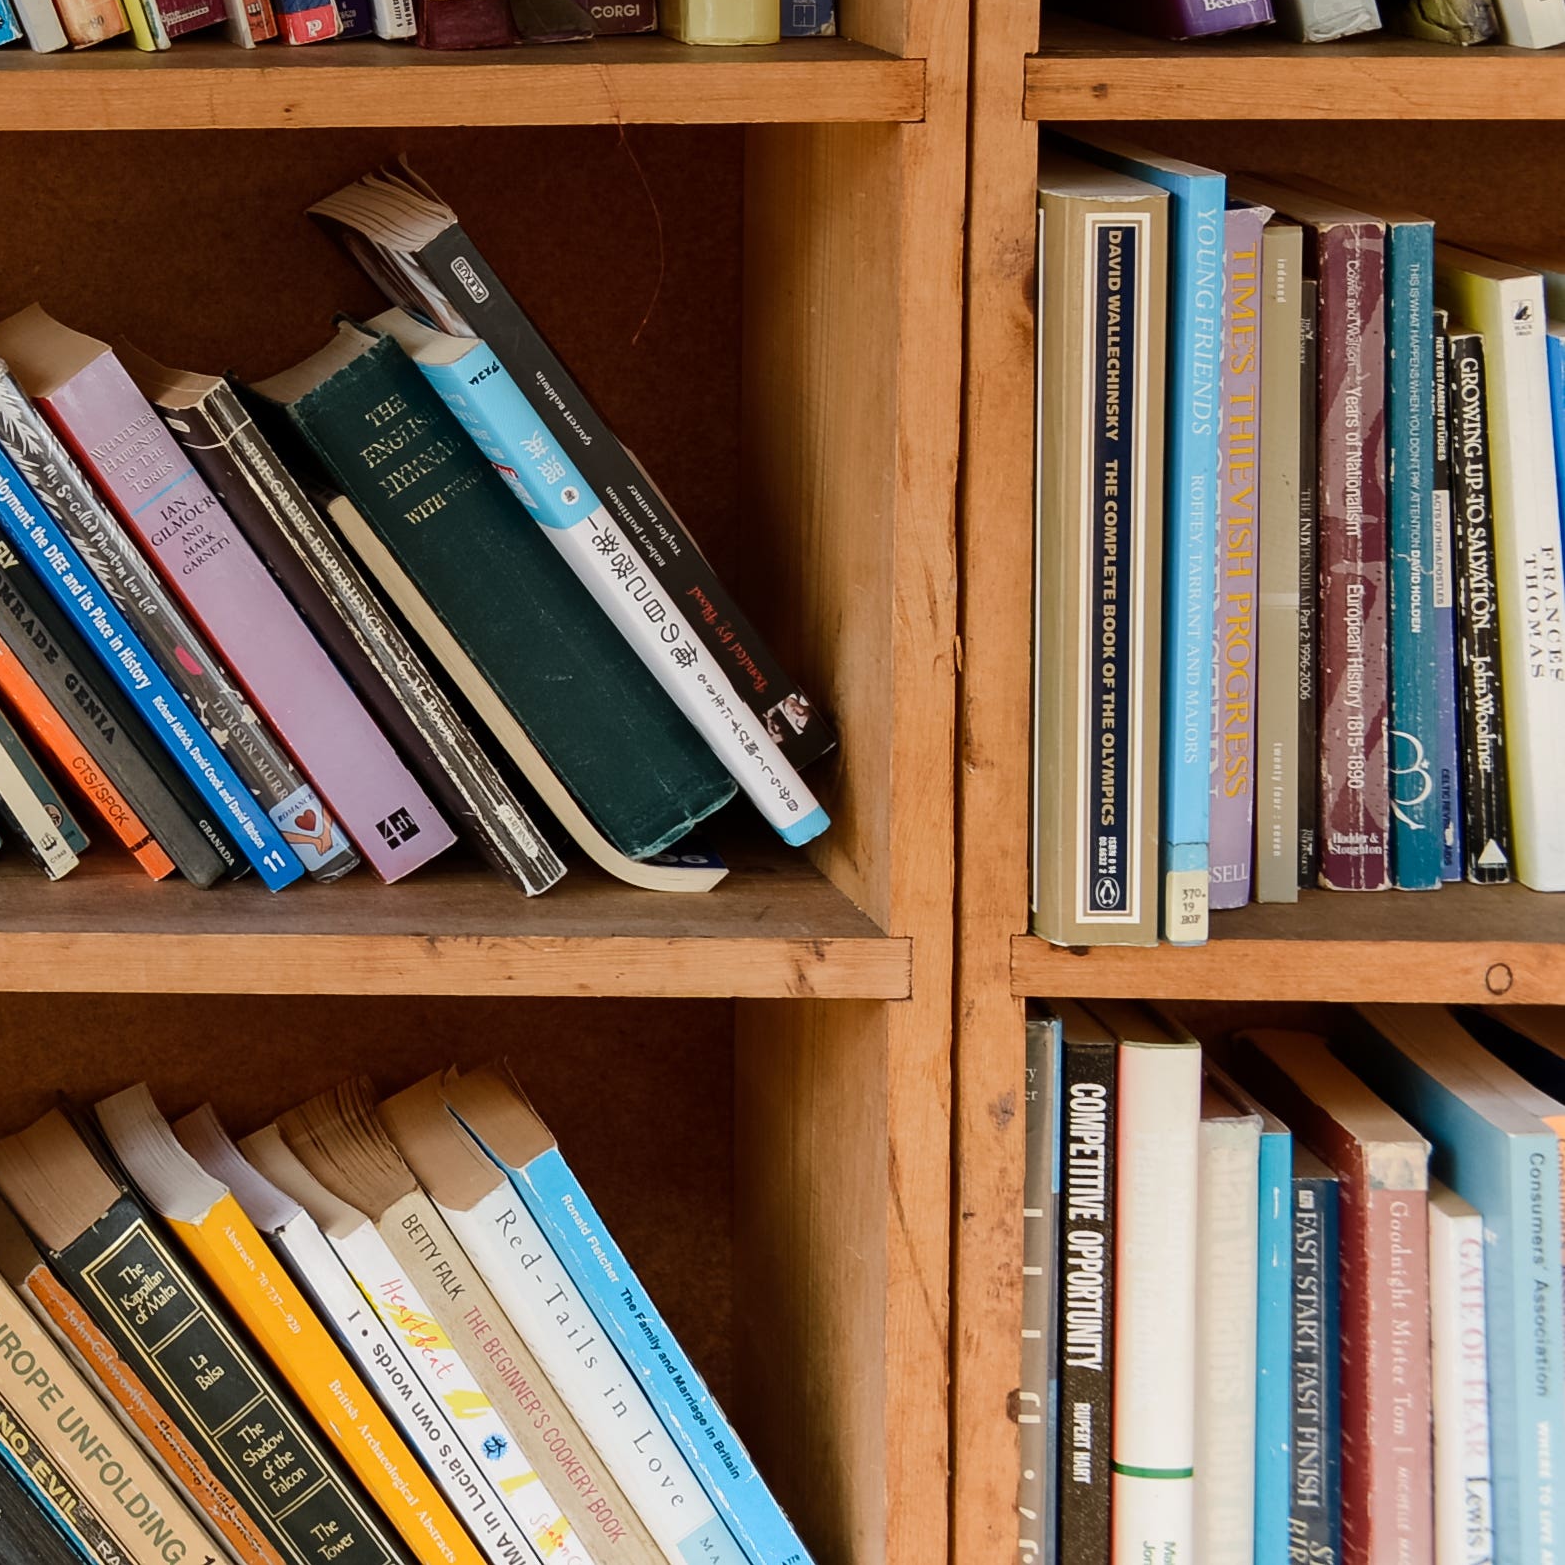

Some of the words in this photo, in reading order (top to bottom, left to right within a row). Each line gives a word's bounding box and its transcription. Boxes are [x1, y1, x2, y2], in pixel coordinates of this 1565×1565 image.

[590, 5, 641, 20] CORGI
[1107, 230, 1122, 295] DAVID
[1105, 298, 1121, 441] WALLECHINSKY
[71, 756, 131, 827] CTS/SPCK
[199, 819, 235, 867] GRANADA
[1069, 1082, 1106, 1221] COMPETITIVE
[401, 1213, 439, 1265] BETTY
[432, 1260, 467, 1302] FALK
[1067, 1231, 1105, 1372] OPPORTUNITY
[1073, 1402, 1091, 1449] RUPERT
[56, 1407, 188, 1565] UNFOLDING
[1072, 1451, 1091, 1484] HART
